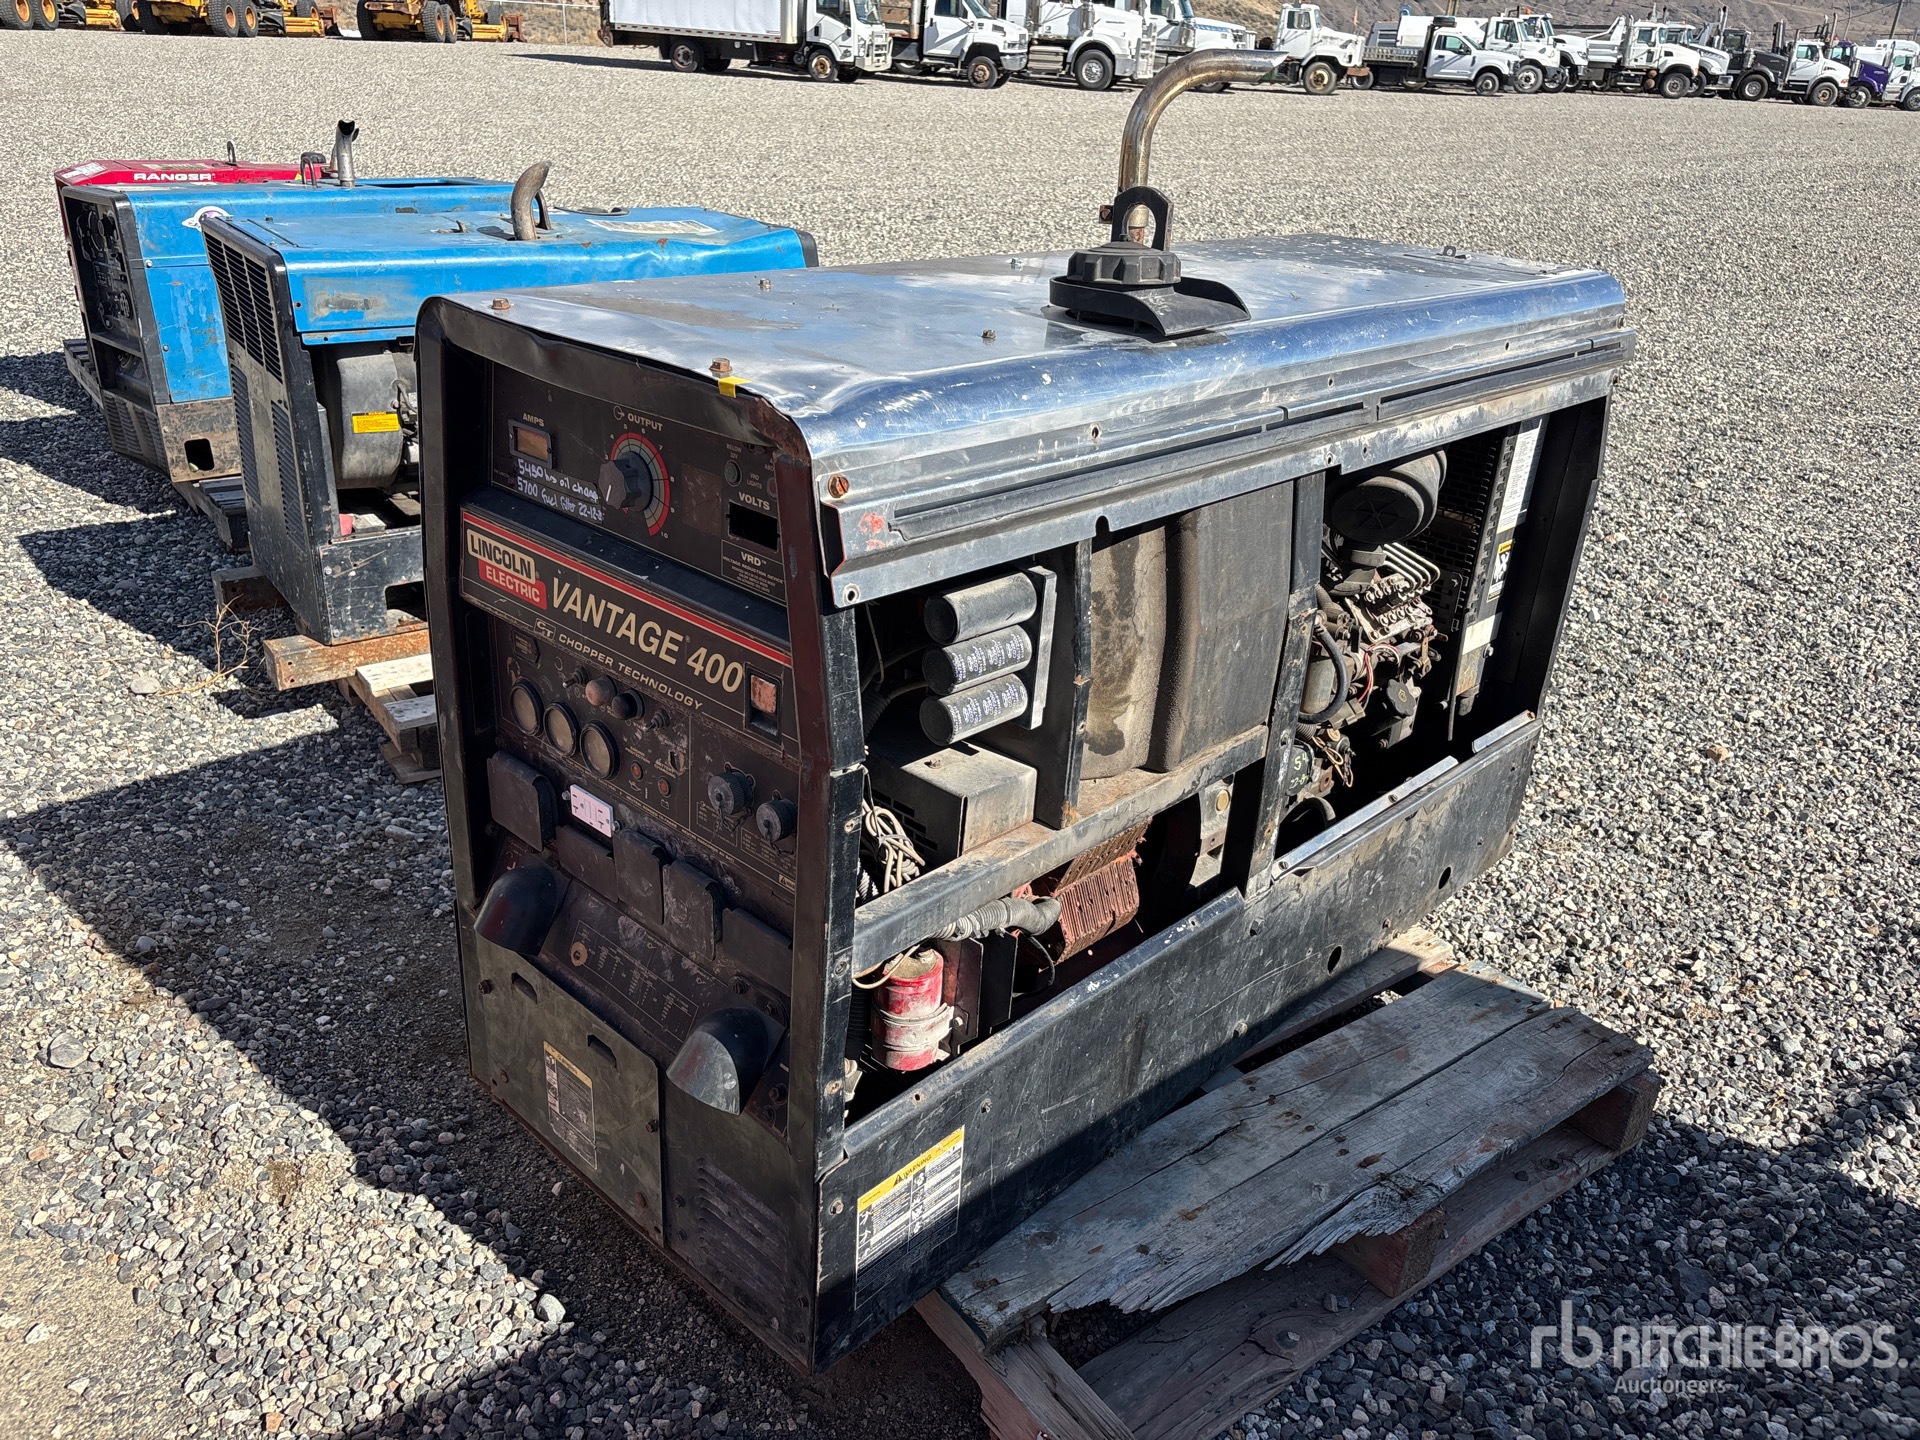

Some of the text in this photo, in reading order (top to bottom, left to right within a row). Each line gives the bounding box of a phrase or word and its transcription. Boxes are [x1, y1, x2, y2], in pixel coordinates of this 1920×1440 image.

[134, 173, 212, 181] RANGER
[522, 412, 544, 427] AMPS
[627, 412, 663, 432] OUTPUT
[517, 476, 538, 497] 5700
[738, 492, 770, 511] VOLTS
[470, 532, 531, 579] LINCOLN
[485, 564, 540, 603] ELECTRIC
[551, 576, 743, 694] VANTAGE 400
[558, 633, 613, 666] CHOPPER
[618, 662, 703, 710] TECHNOLOGY
